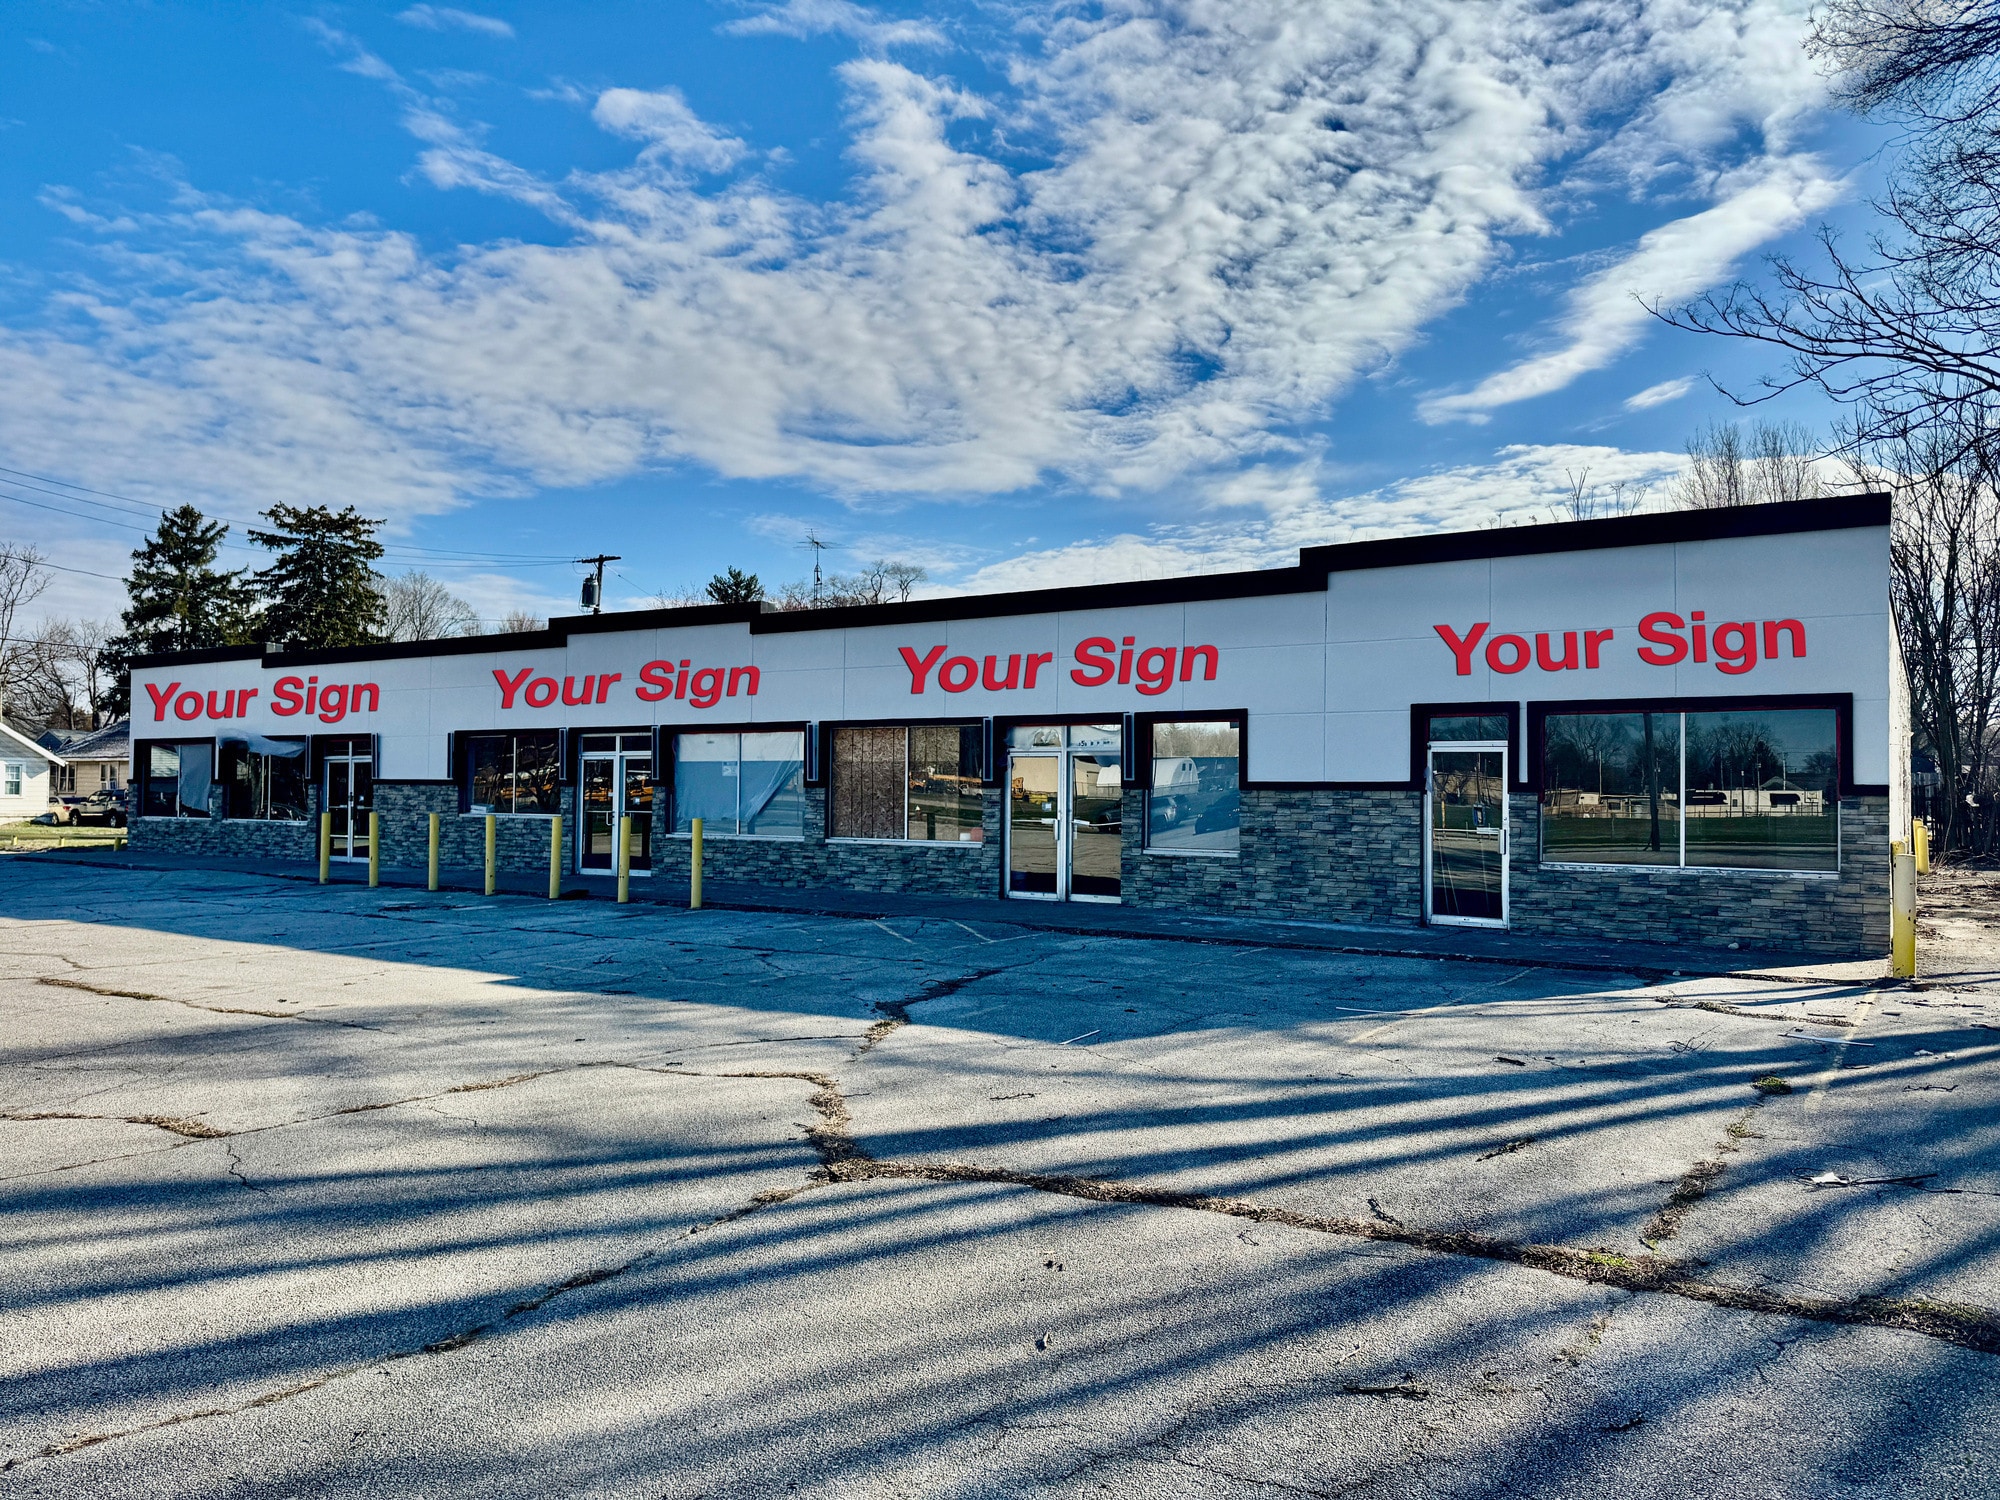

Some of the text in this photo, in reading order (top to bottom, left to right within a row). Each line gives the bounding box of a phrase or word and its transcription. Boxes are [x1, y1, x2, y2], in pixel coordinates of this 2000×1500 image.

[899, 636, 1219, 695] Your Sign
[1434, 611, 1807, 676] Your Sign
[145, 675, 380, 723] Your Sign
[493, 659, 761, 709] Your Sign
